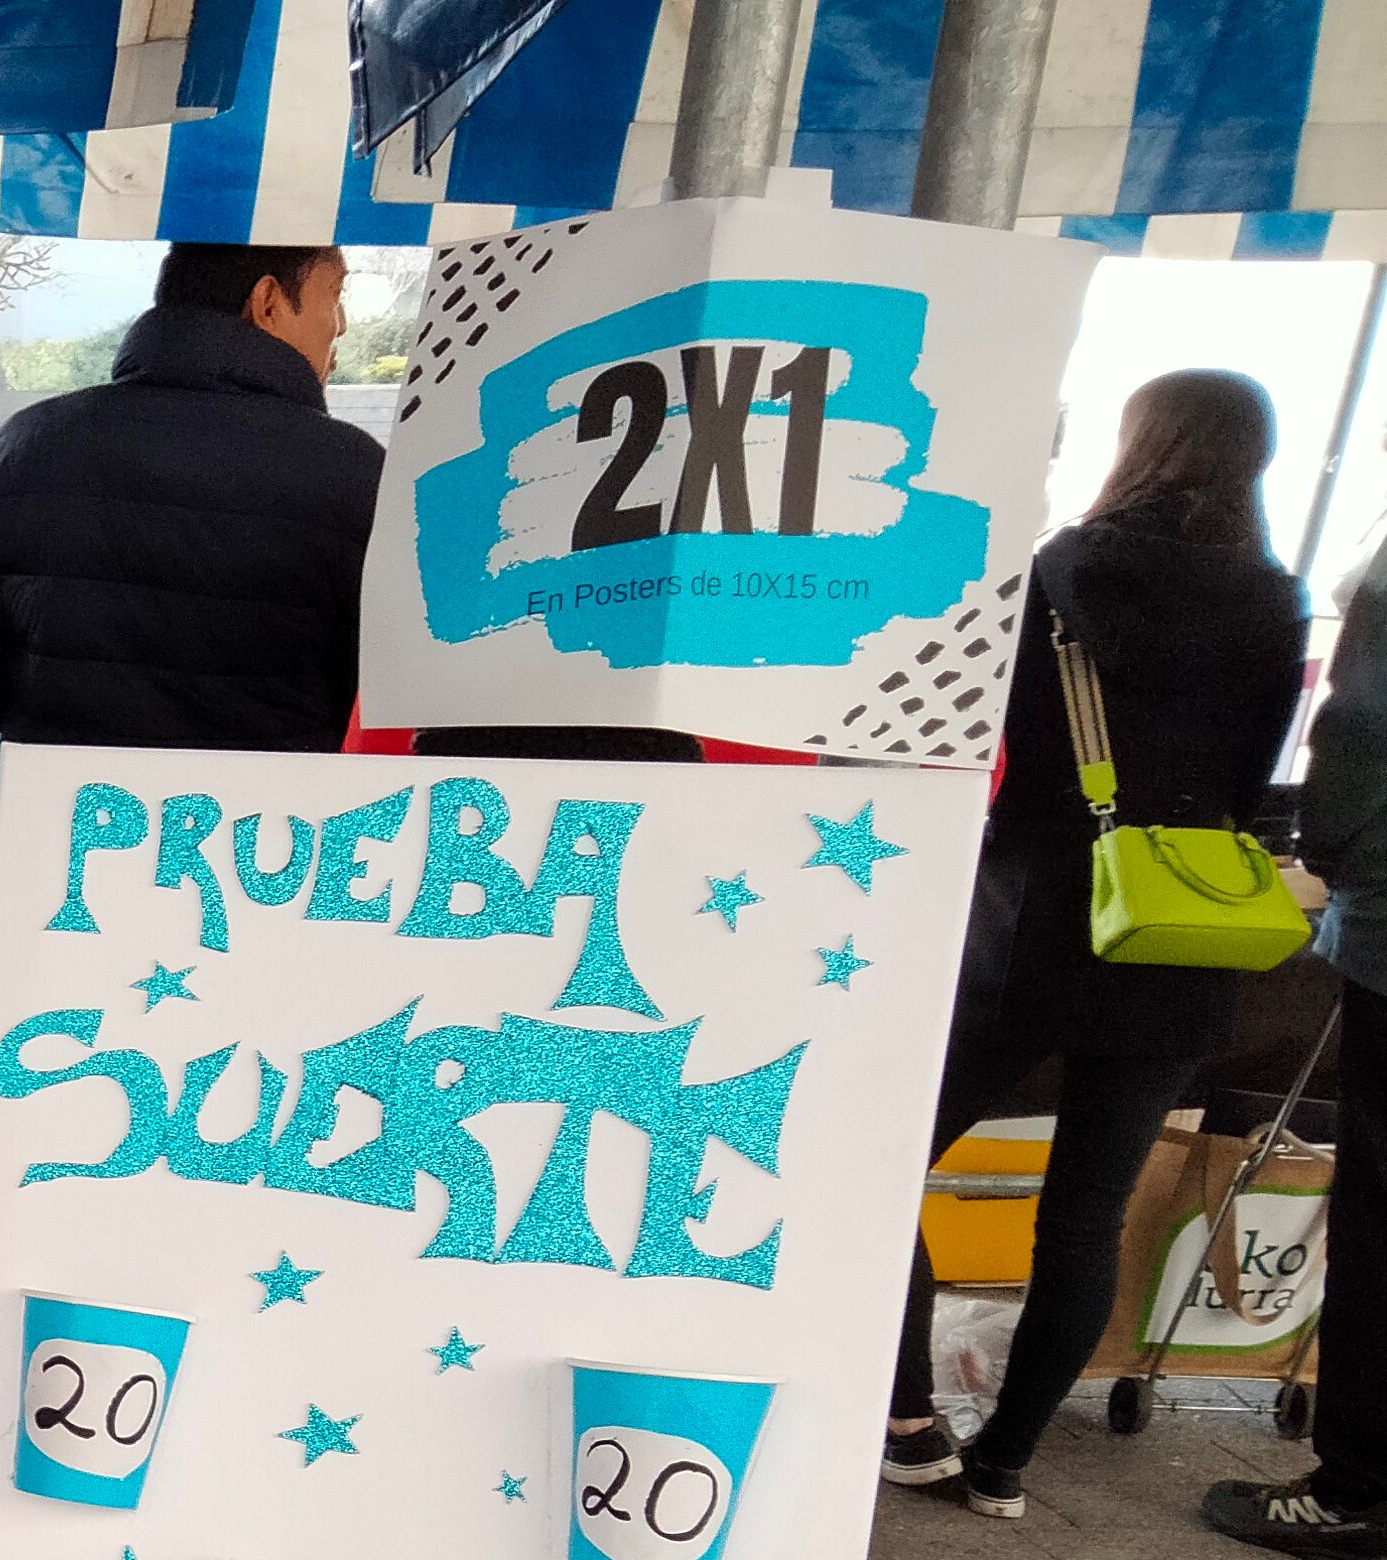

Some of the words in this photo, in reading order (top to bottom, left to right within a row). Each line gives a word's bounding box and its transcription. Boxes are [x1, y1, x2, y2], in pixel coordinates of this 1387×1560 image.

[570, 345, 831, 552] 2X1
[527, 589, 563, 615] En
[575, 575, 682, 609] Posters
[690, 570, 722, 597] de
[731, 571, 817, 599] 10X15
[826, 578, 870, 600] cm
[44, 777, 665, 1023] PRUEBA
[1203, 1229, 1308, 1278] ko
[34, 1354, 161, 1447] 20
[578, 1438, 721, 1545] 20
